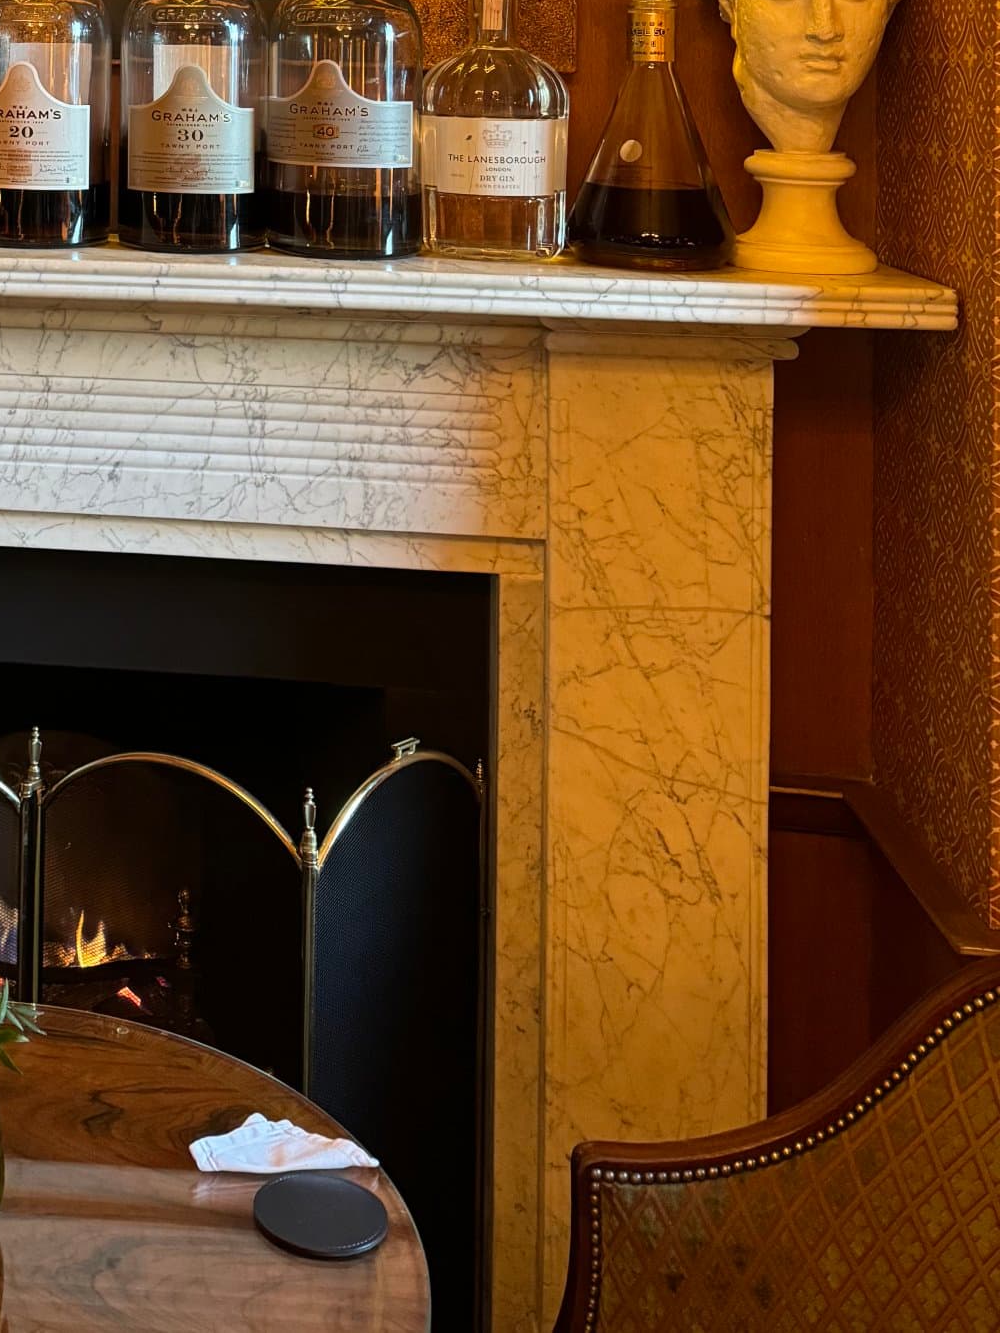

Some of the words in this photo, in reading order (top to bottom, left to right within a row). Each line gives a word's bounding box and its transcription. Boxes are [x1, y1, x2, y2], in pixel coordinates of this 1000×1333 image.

[290, 103, 368, 116] GRAHAM'S
[151, 110, 232, 122] GRAHAM'S
[9, 126, 34, 138] 20
[177, 129, 204, 142] 30
[316, 126, 334, 136] 40
[448, 154, 464, 162] THE
[467, 156, 546, 164] LANESBOROUGH
[480, 174, 497, 182] DRY
[498, 174, 516, 182] GIN
